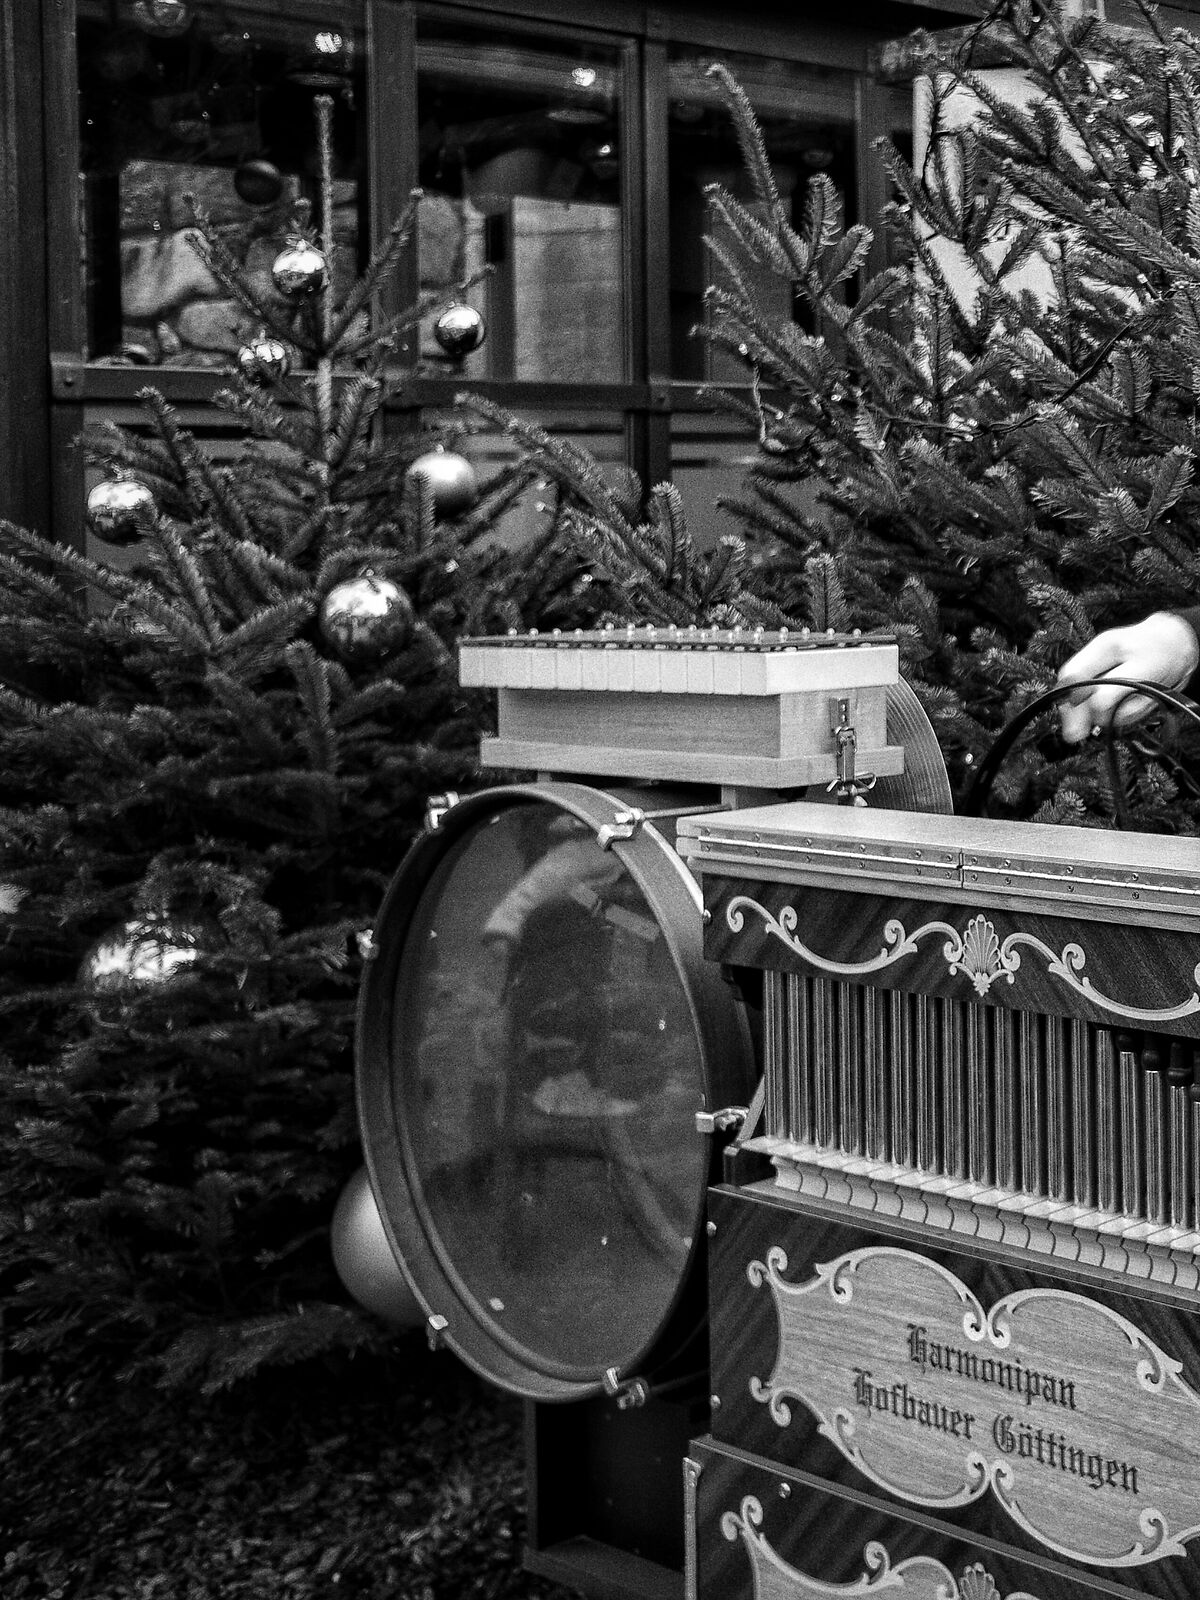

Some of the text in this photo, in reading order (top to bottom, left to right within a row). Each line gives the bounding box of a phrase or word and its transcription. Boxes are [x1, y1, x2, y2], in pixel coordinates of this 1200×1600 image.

[906, 1323, 1079, 1410] Harmonipan
[852, 1367, 1141, 1494] Hofbauer Göttingen
